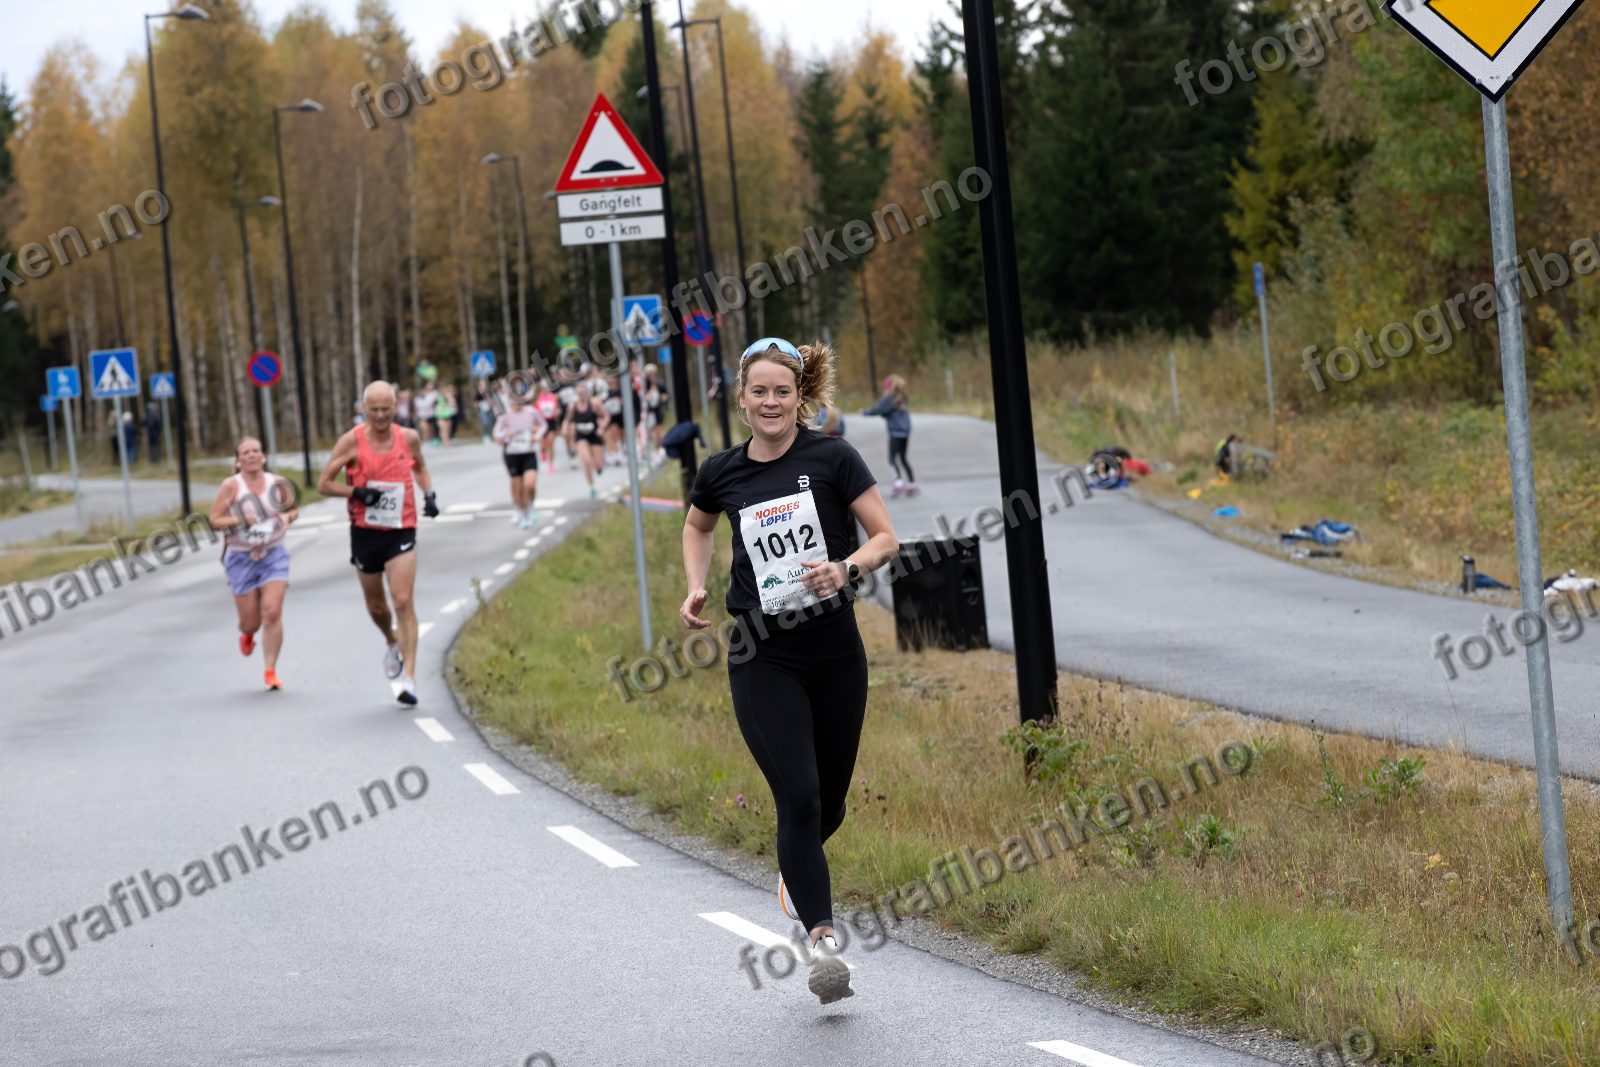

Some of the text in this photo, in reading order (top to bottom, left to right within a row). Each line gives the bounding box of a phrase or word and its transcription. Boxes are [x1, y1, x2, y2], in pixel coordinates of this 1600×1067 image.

[579, 195, 642, 211] Gangfelt
[585, 226, 595, 239] 0
[610, 224, 616, 237] 1
[620, 223, 641, 236] km
[755, 501, 800, 519] NORGES
[760, 511, 794, 528] LØPET
[753, 524, 817, 562] 1012
[787, 566, 812, 579] Aurs
